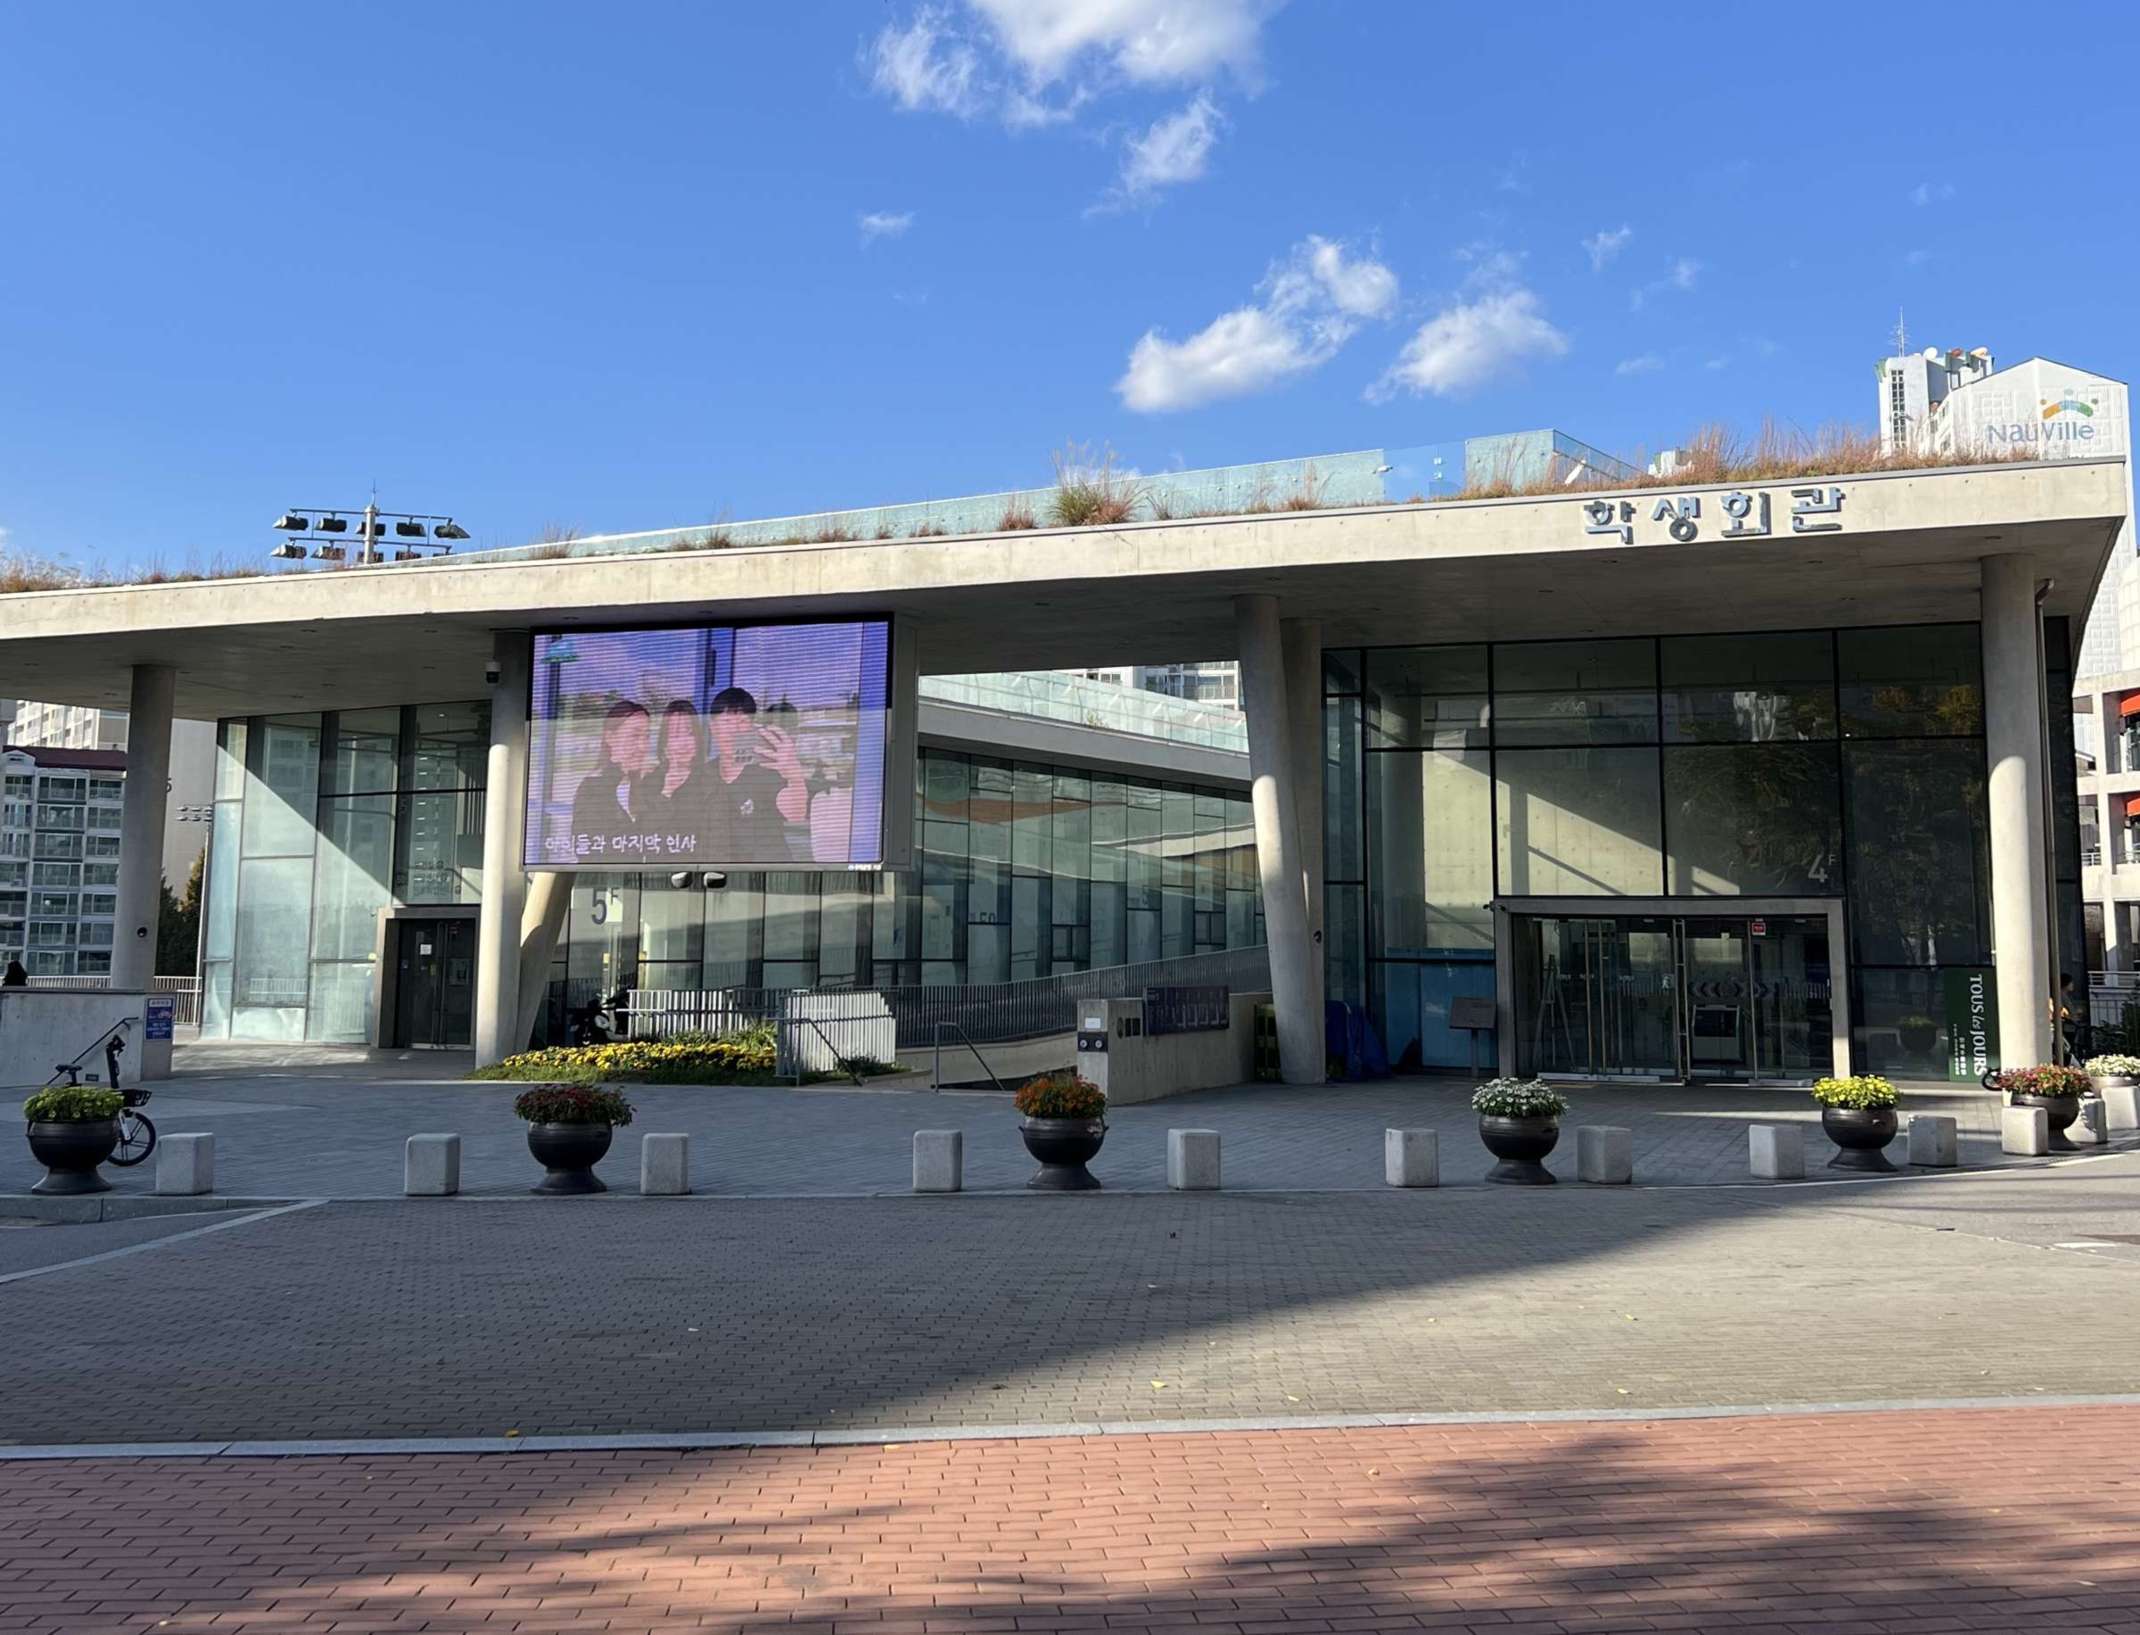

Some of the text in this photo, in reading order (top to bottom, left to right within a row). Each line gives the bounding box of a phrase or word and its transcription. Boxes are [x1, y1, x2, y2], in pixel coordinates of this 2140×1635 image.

[1583, 487, 1846, 545] 학생회관
[611, 833, 661, 854] 마지막
[666, 833, 697, 853] 인사
[1969, 973, 1985, 1013] TOUS
[1969, 1030, 1988, 1076] JOURS
